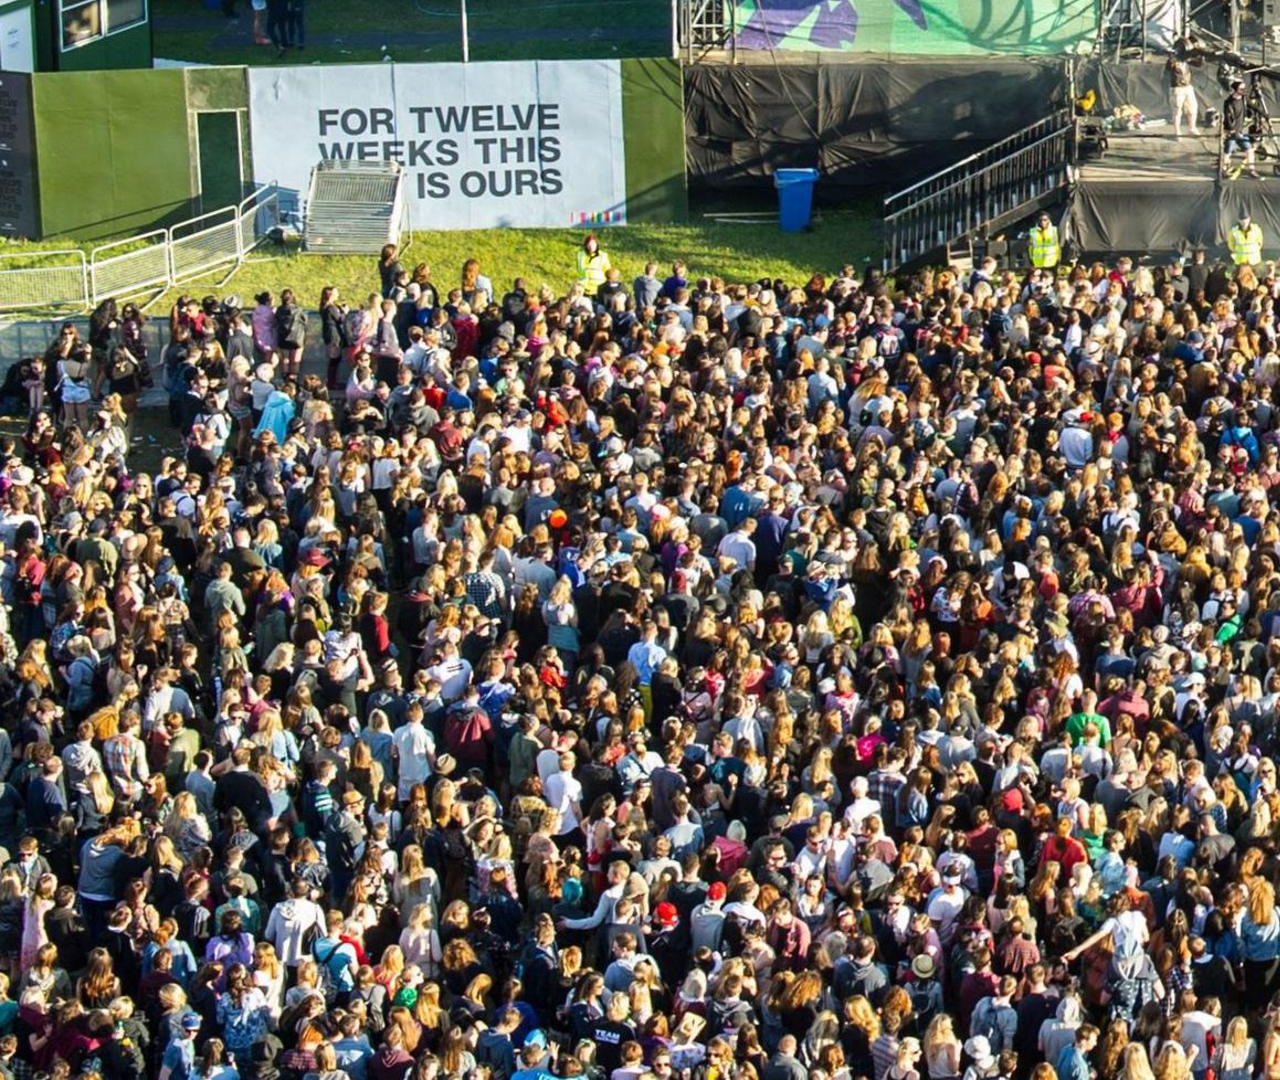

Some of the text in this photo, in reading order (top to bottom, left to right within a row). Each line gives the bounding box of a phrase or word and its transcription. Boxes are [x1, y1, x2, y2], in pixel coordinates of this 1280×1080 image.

[318, 104, 560, 136] FOR TWELVE
[318, 136, 561, 167] WEEKS THIS
[417, 168, 563, 199] IS OURS
[595, 1028, 621, 1038] TEAM
